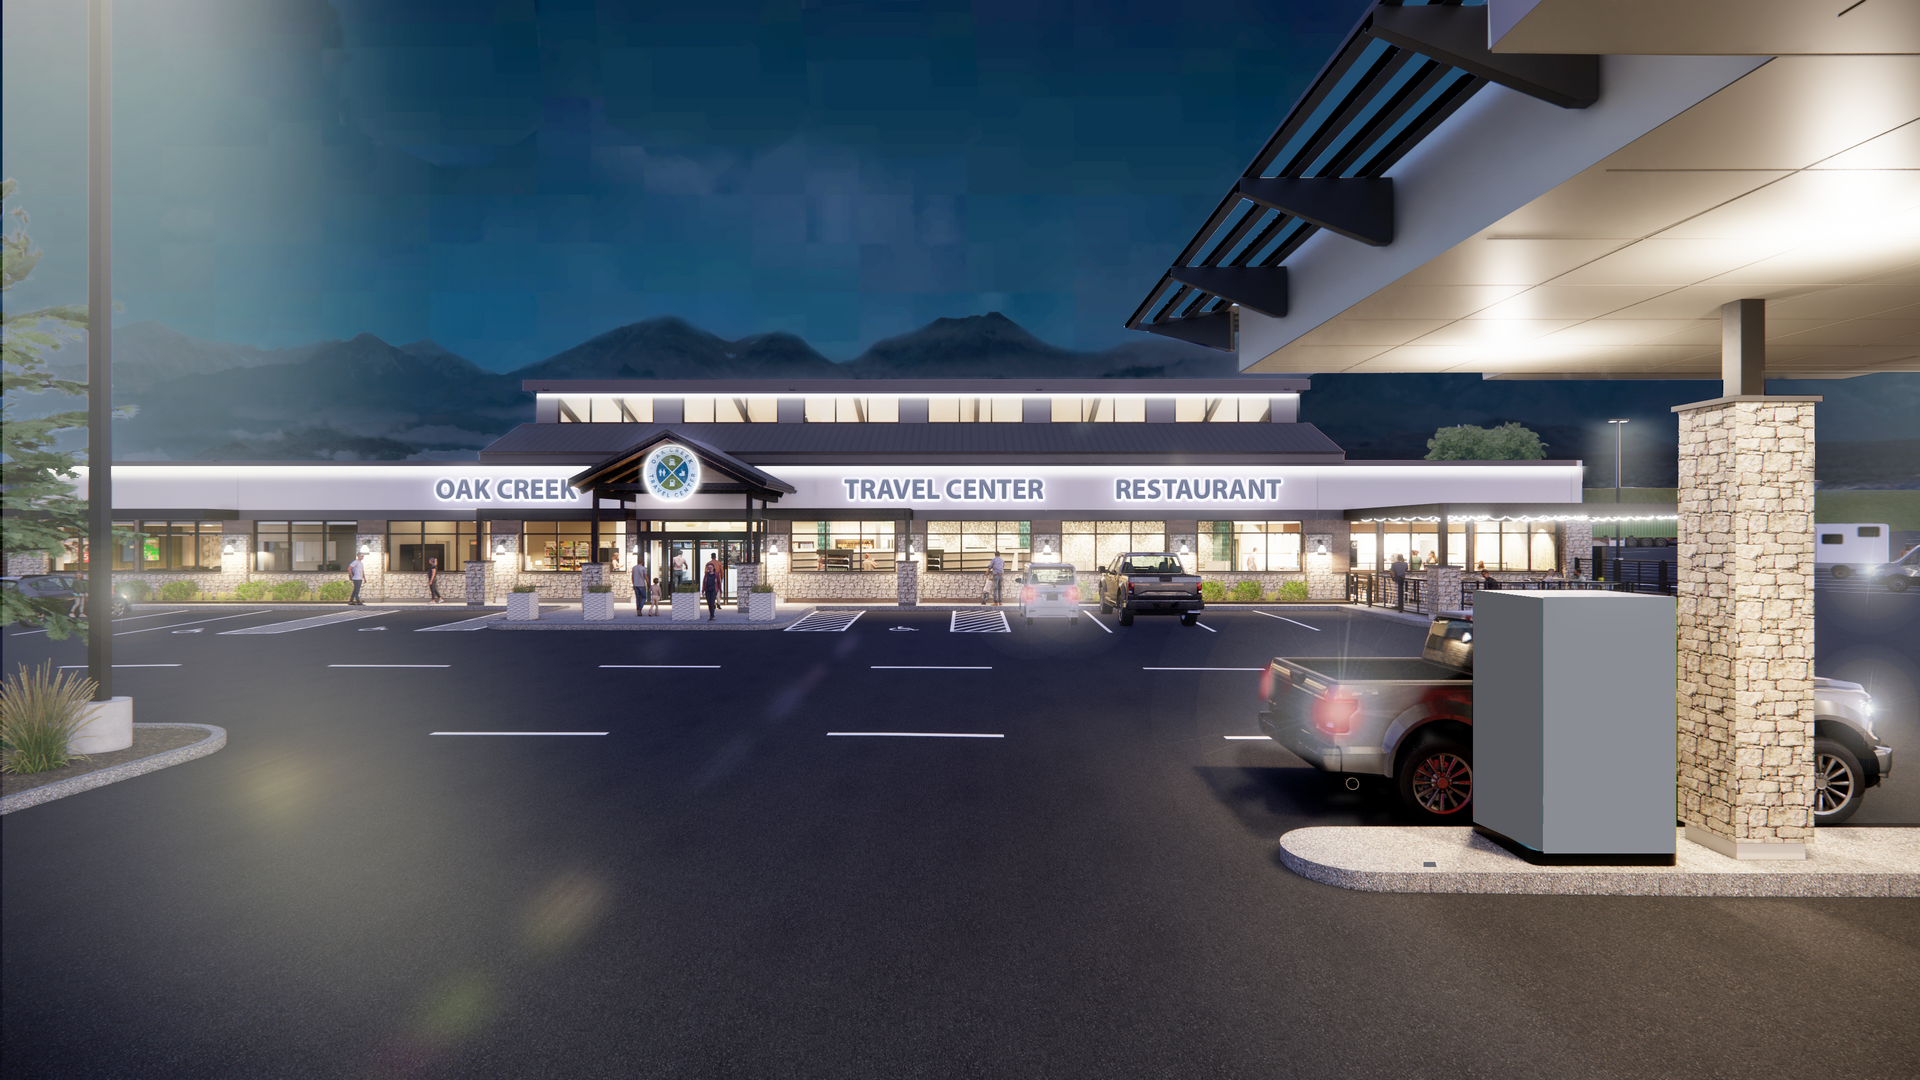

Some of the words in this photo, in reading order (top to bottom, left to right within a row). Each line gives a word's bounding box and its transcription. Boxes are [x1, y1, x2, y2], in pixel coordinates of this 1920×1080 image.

[651, 450, 666, 464] OAK
[669, 447, 693, 464] CREEK
[435, 478, 491, 500] OAK
[496, 478, 577, 500] CREEK
[649, 474, 670, 498] TRAVEL
[674, 473, 696, 498] CENTER
[844, 478, 940, 500] TRAVEL
[945, 478, 1044, 500] CENTER
[1116, 478, 1282, 500] RESTAURANT
